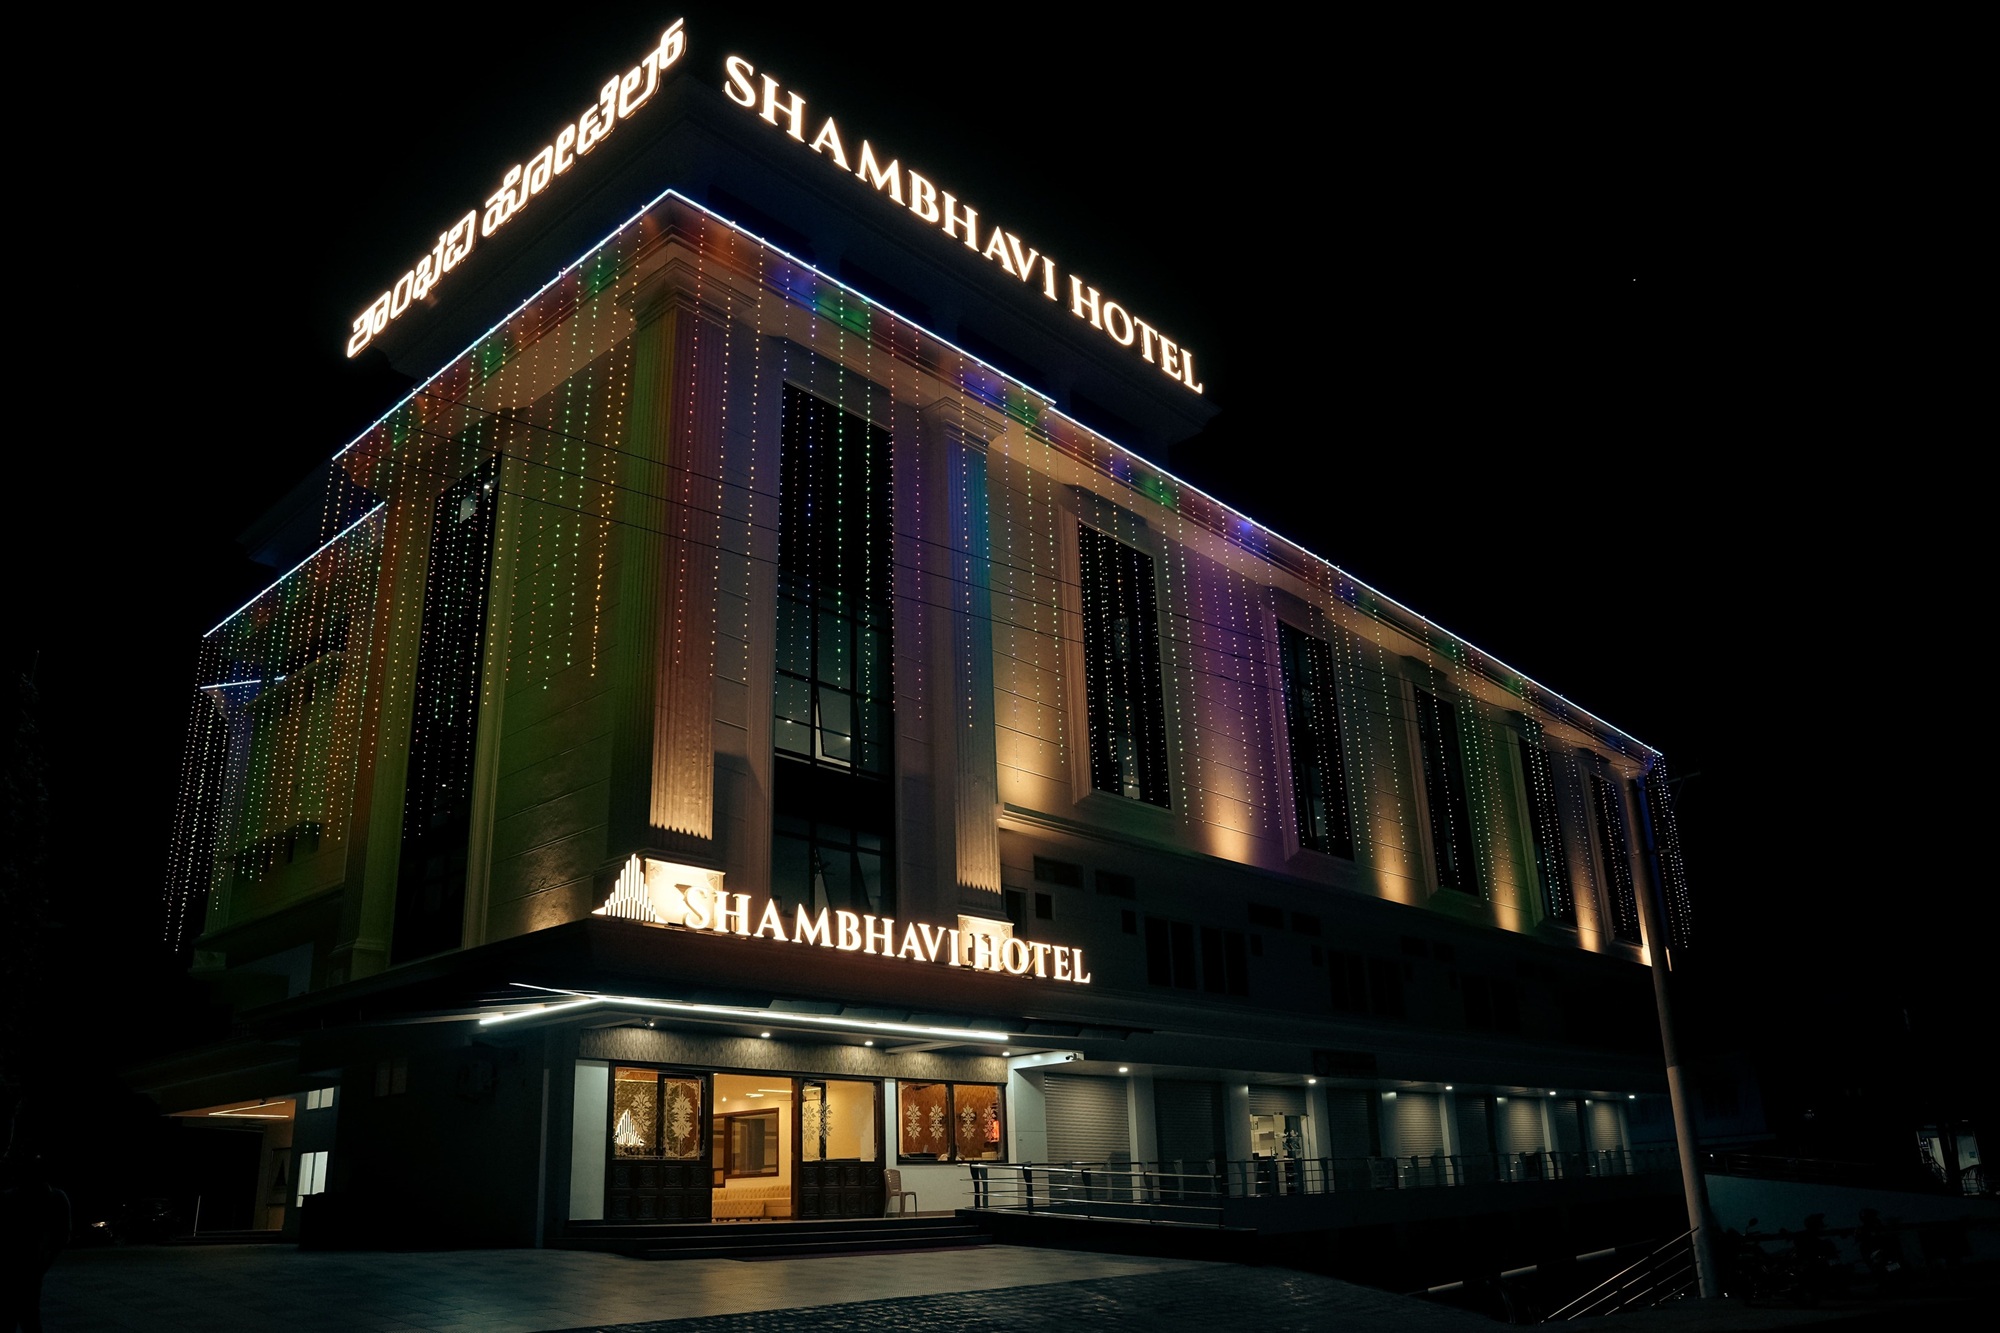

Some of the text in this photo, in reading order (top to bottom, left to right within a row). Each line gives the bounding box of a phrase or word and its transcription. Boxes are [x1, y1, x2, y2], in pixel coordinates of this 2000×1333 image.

[346, 209, 477, 358] ಶಾಂಭವಿ
[723, 55, 1204, 395] SHAMBHAVI HOTEL
[683, 885, 1092, 985] SHAMBHAVI HOTEL
